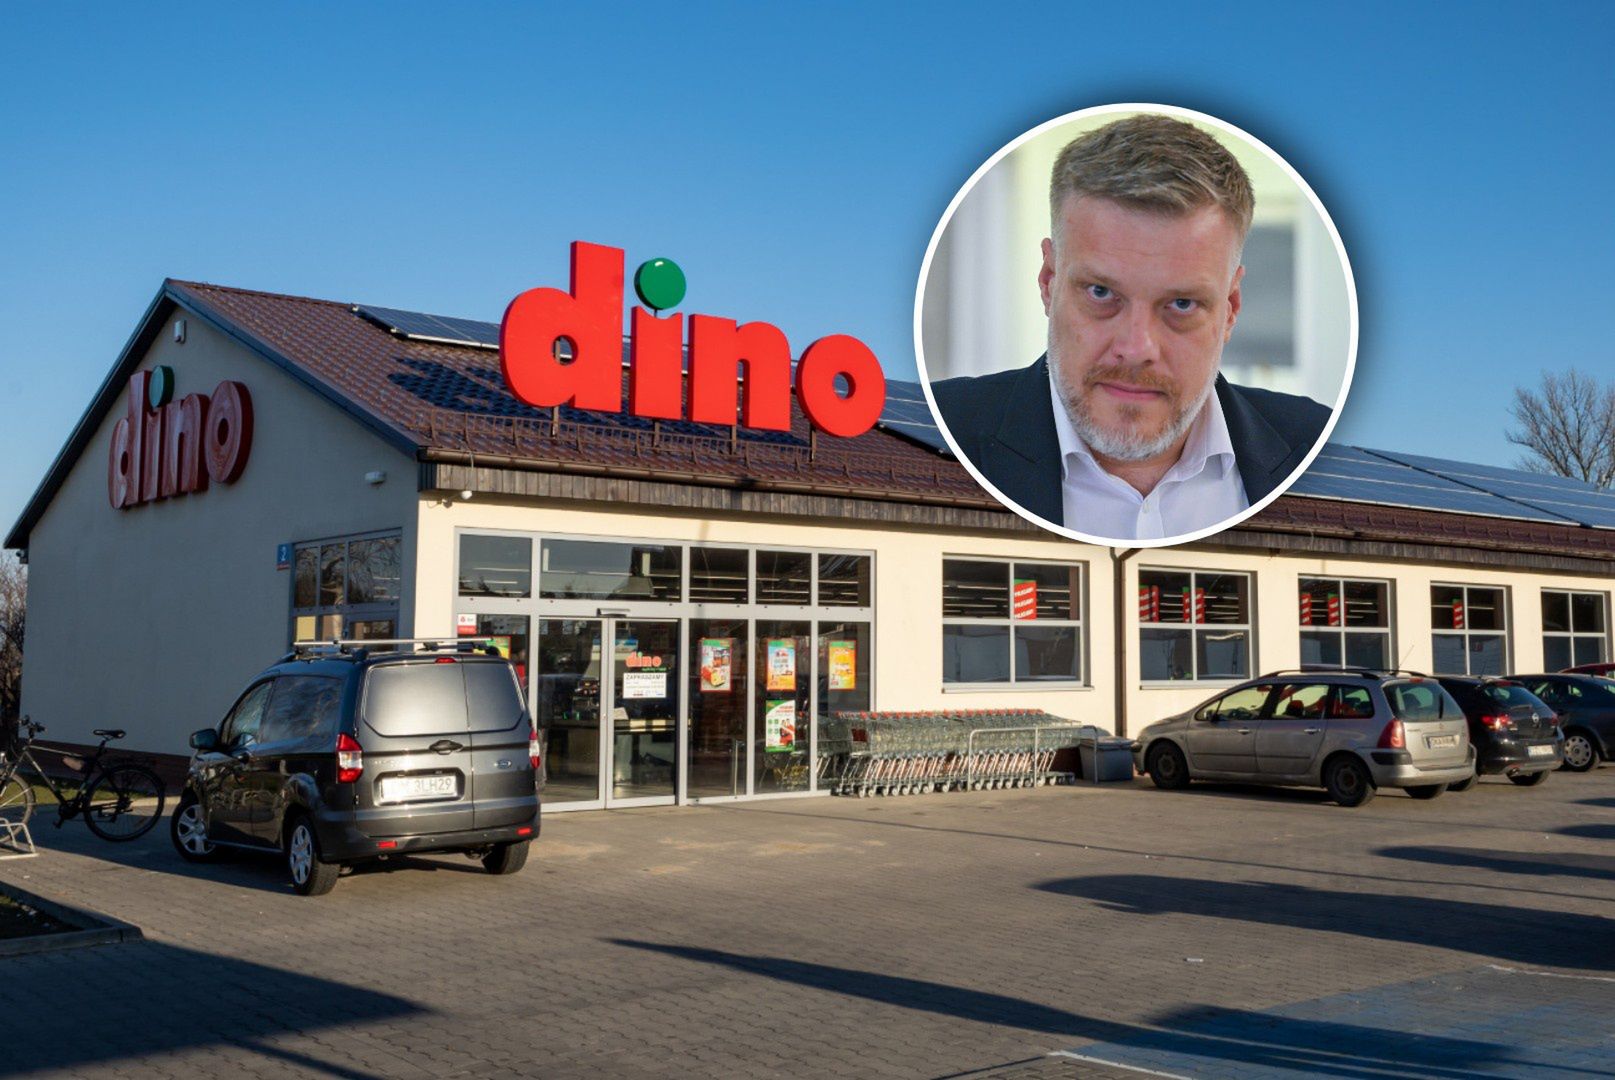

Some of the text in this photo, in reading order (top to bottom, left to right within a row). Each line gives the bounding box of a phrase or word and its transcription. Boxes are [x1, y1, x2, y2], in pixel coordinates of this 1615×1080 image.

[500, 241, 886, 438] dino
[108, 365, 254, 510] dino
[625, 651, 662, 667] dino
